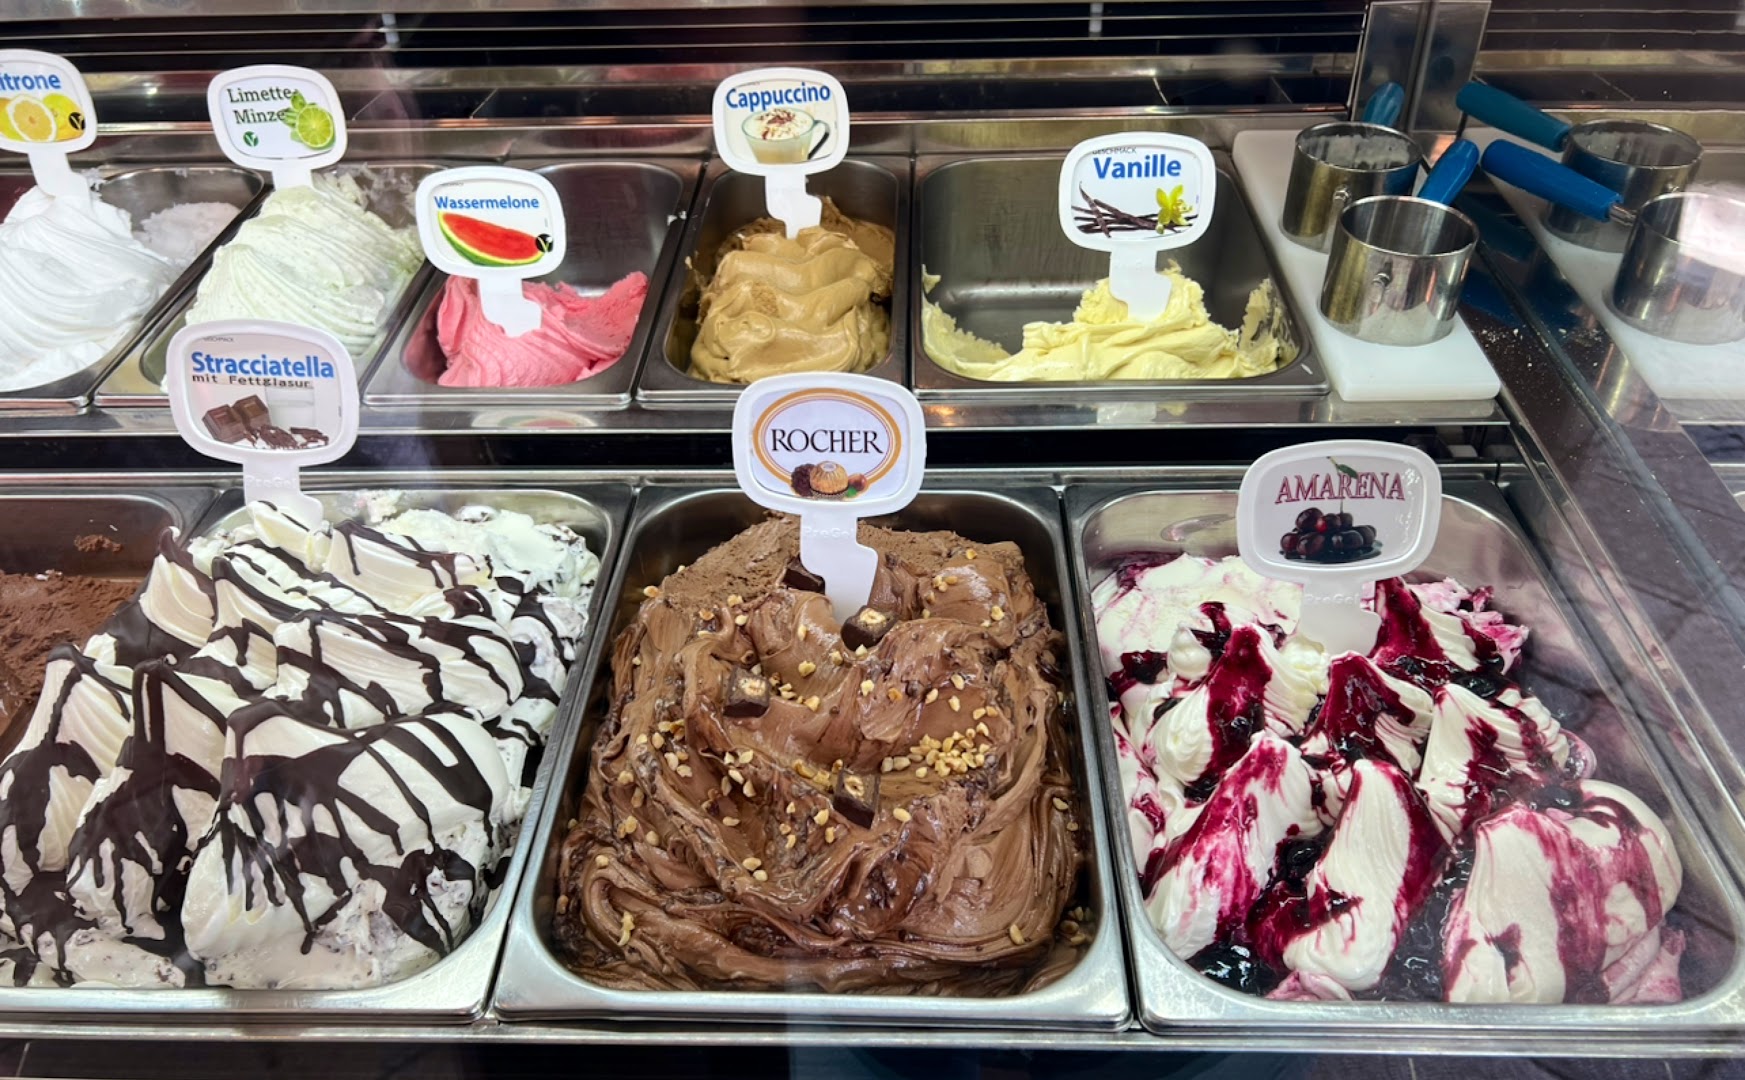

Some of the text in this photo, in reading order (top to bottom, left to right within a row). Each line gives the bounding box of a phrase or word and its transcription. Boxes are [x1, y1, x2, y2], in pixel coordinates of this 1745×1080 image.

[726, 82, 831, 112] Cappuccino
[233, 109, 286, 124] Minze
[1093, 154, 1182, 179] Vanille
[434, 195, 539, 209] Wassermelone
[191, 351, 335, 378] Stracciatella
[192, 374, 312, 388] mit Fettglasur
[770, 428, 883, 454] ROCHER
[1274, 471, 1406, 504] AMARENA
